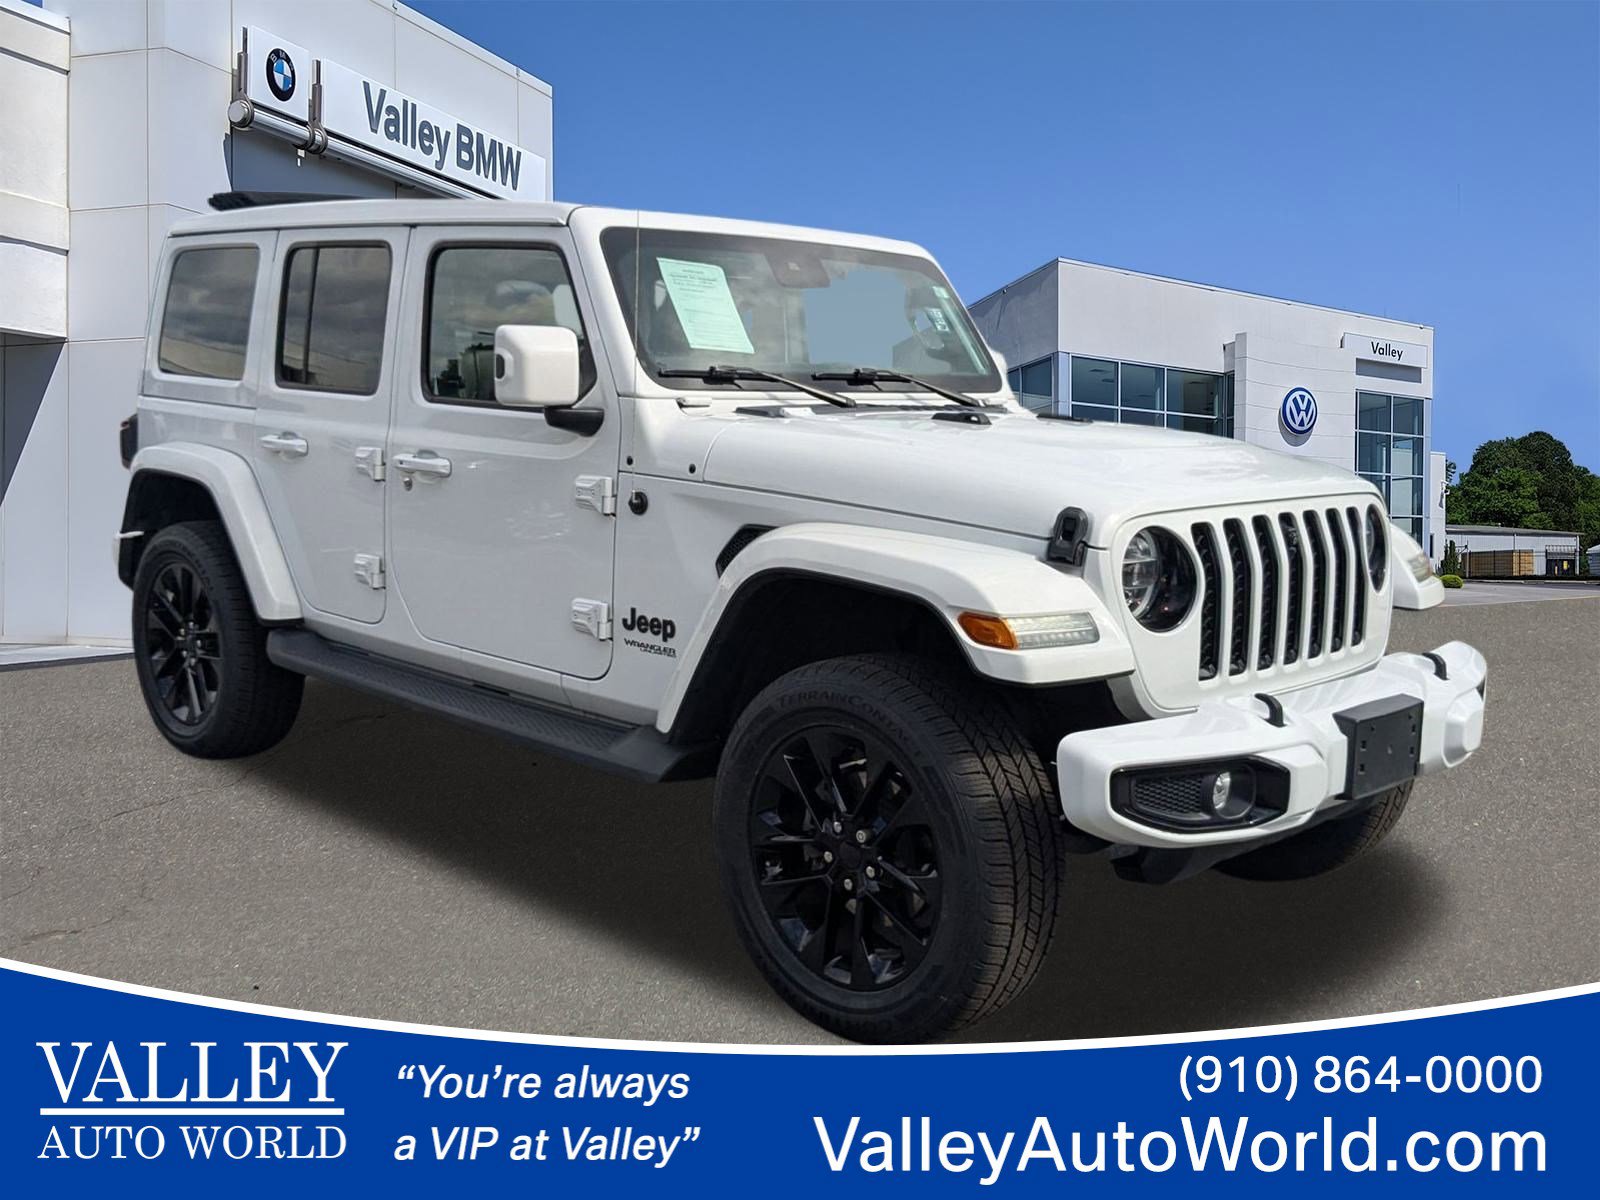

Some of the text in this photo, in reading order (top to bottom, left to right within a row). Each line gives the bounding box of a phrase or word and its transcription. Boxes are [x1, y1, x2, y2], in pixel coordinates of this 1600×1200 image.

[363, 81, 522, 191] Valley BMW
[1371, 341, 1403, 361] Valley
[622, 607, 676, 642] Jeep
[623, 637, 676, 656] WRANGLER
